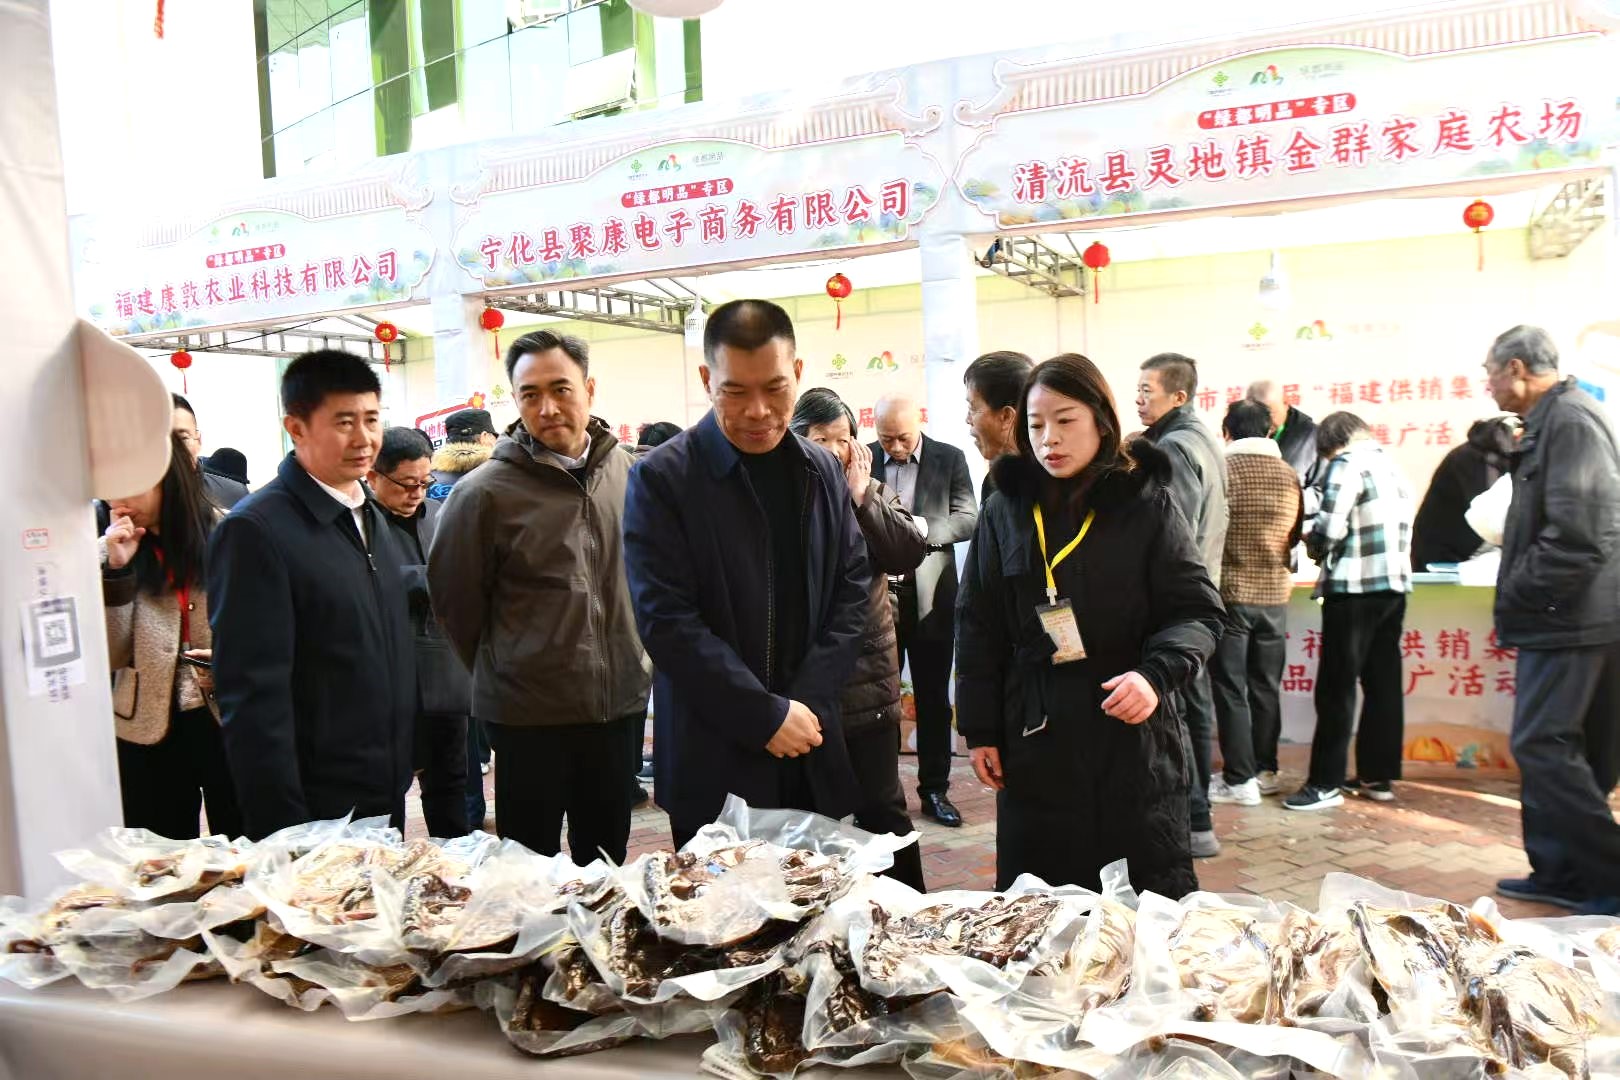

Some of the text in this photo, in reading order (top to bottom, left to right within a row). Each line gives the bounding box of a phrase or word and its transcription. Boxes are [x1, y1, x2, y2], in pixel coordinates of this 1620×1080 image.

[1013, 100, 1583, 202] 清流县灵地镇金群家庭农场
[479, 181, 909, 270] 宁化县聚康电子商务有限公司
[115, 250, 398, 318] 福建康敦农业科技有限公司
